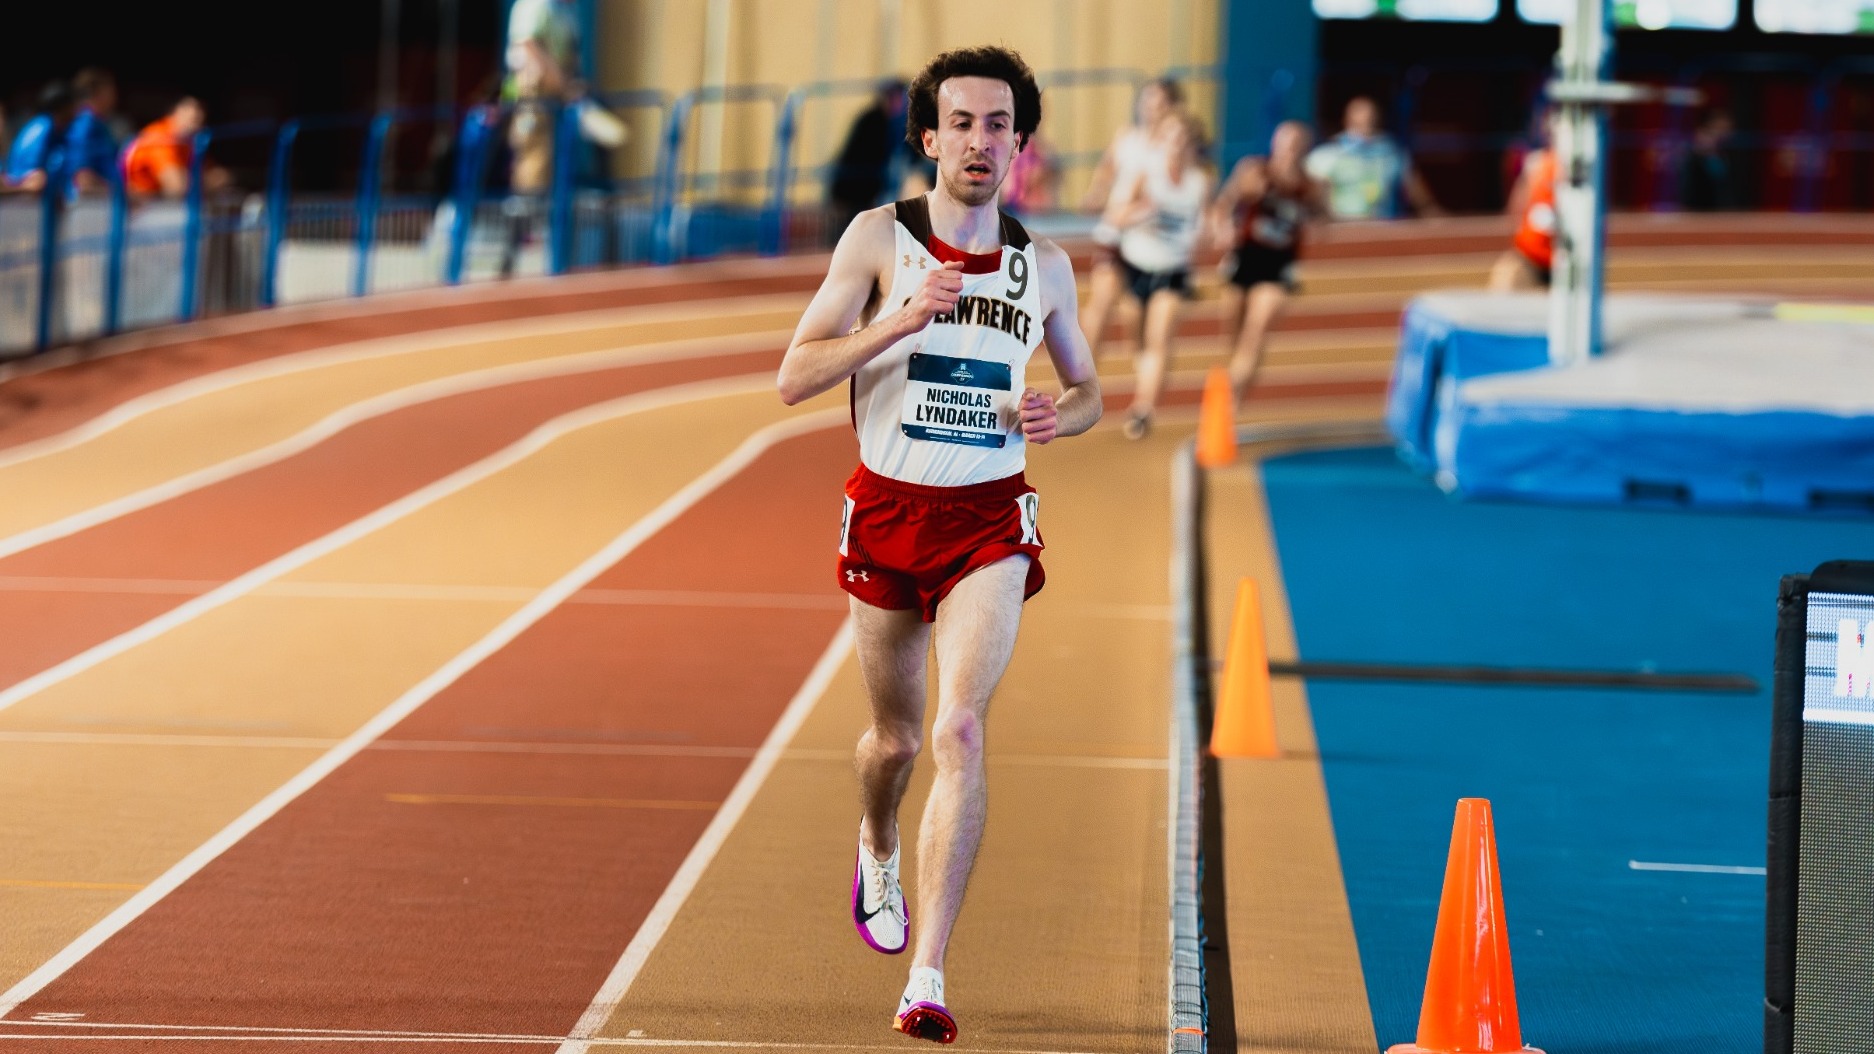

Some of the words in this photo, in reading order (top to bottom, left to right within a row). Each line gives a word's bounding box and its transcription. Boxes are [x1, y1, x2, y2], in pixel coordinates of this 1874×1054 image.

[1006, 251, 1028, 301] 9
[926, 387, 992, 408] NICHOLAS
[915, 404, 998, 430] LYNDAKER
